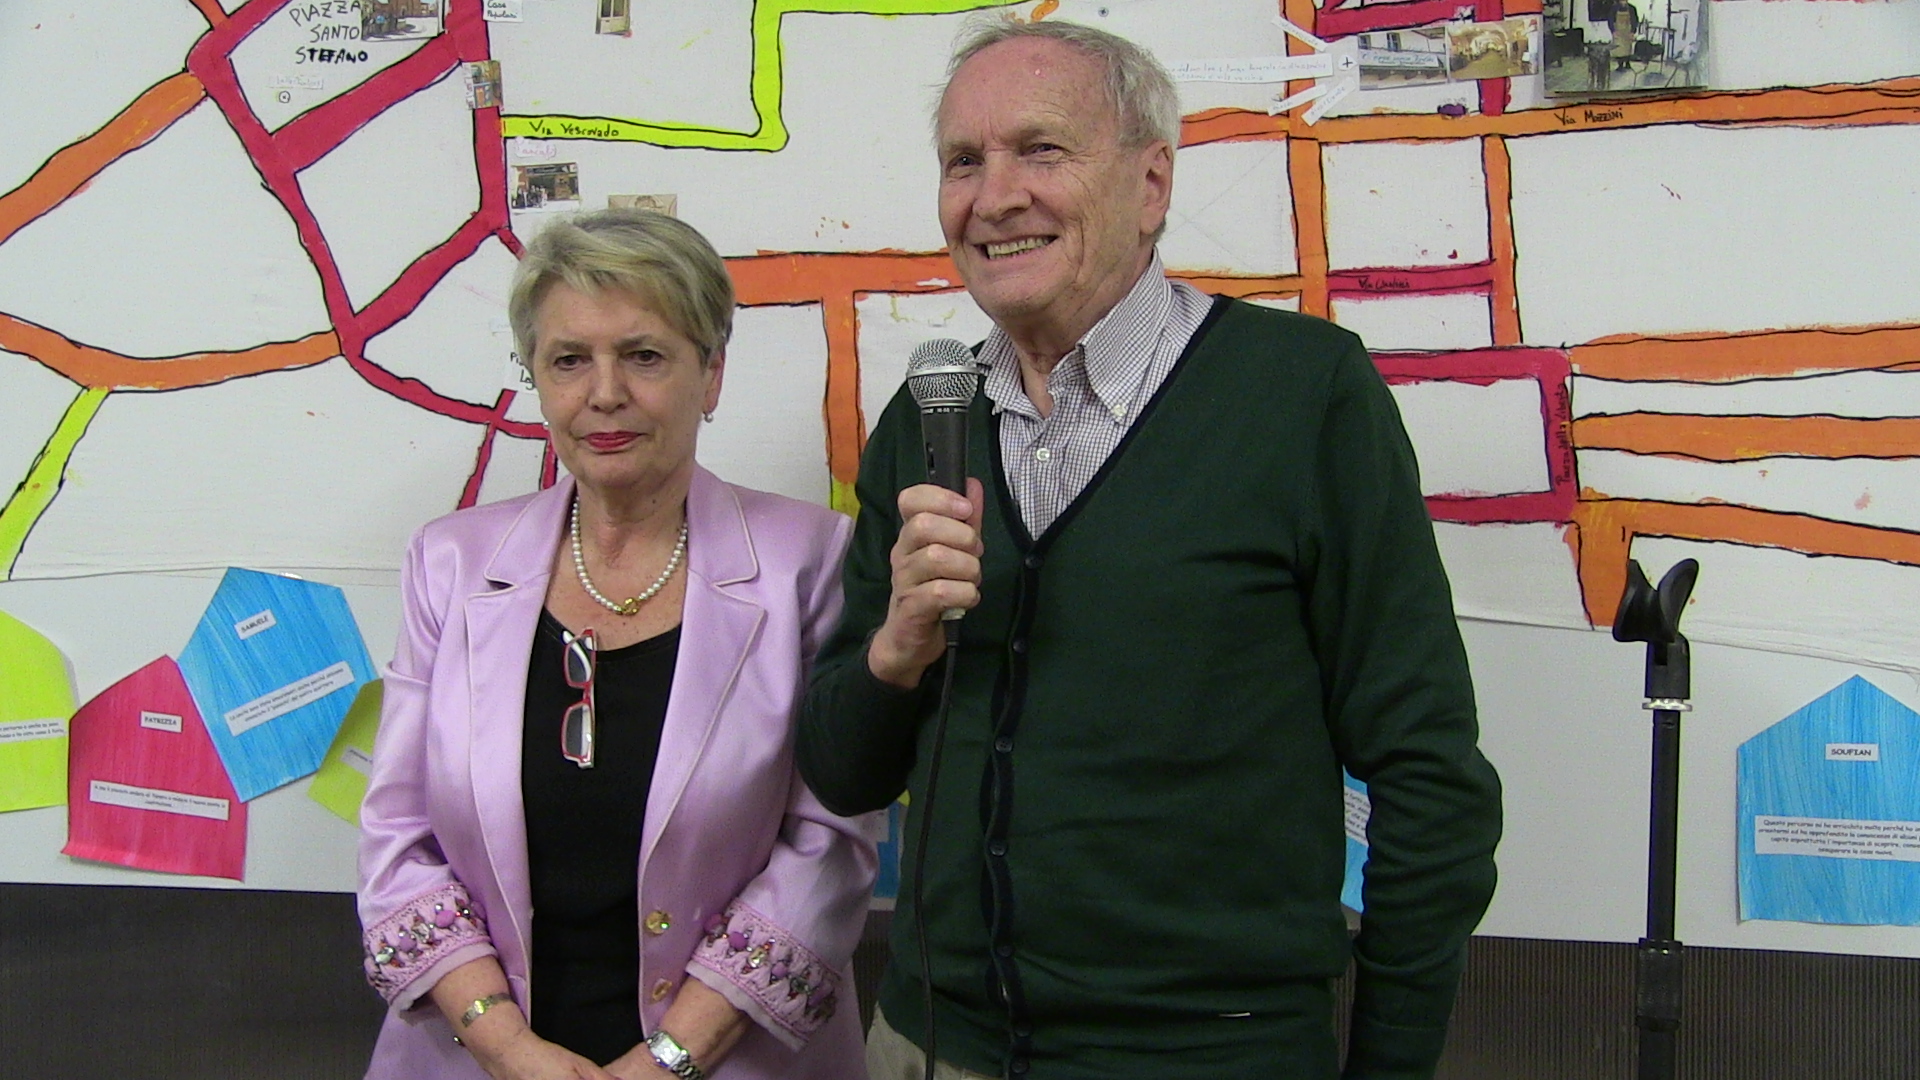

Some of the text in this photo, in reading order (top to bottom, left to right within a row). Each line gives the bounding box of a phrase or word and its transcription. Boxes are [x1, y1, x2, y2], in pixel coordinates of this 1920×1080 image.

[289, 0, 361, 27] PIAZZA
[310, 24, 360, 44] SANTO
[295, 46, 368, 64] STEFANO
[1553, 107, 1577, 126] Via
[529, 120, 553, 136] Via
[144, 715, 177, 726] PATRIZIA
[1830, 748, 1872, 757] SOUFIAN
